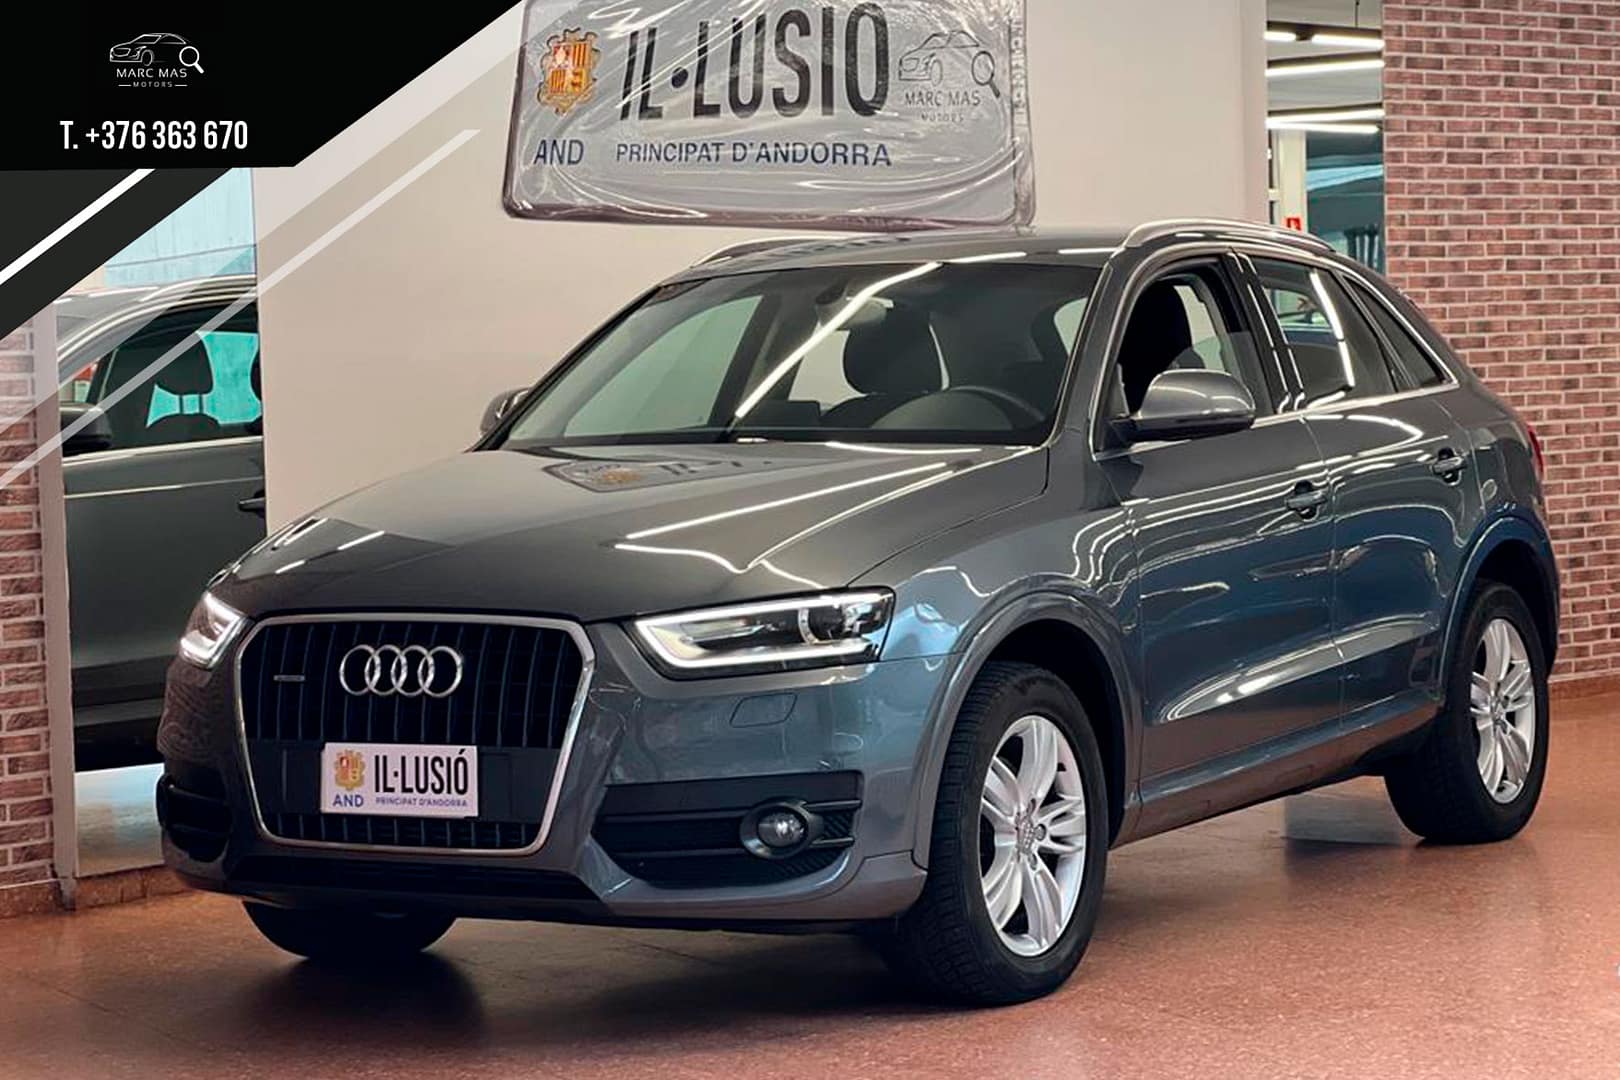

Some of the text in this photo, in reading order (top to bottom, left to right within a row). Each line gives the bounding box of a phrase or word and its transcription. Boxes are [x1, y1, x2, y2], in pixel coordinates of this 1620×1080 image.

[904, 89, 981, 107] MARC MAS
[533, 138, 585, 165] AND
[615, 141, 893, 167] PRINCIPAT D'ANDORRA
[332, 794, 364, 808] AND
[375, 797, 468, 808] PRINCIPAT D'ANDORRA
